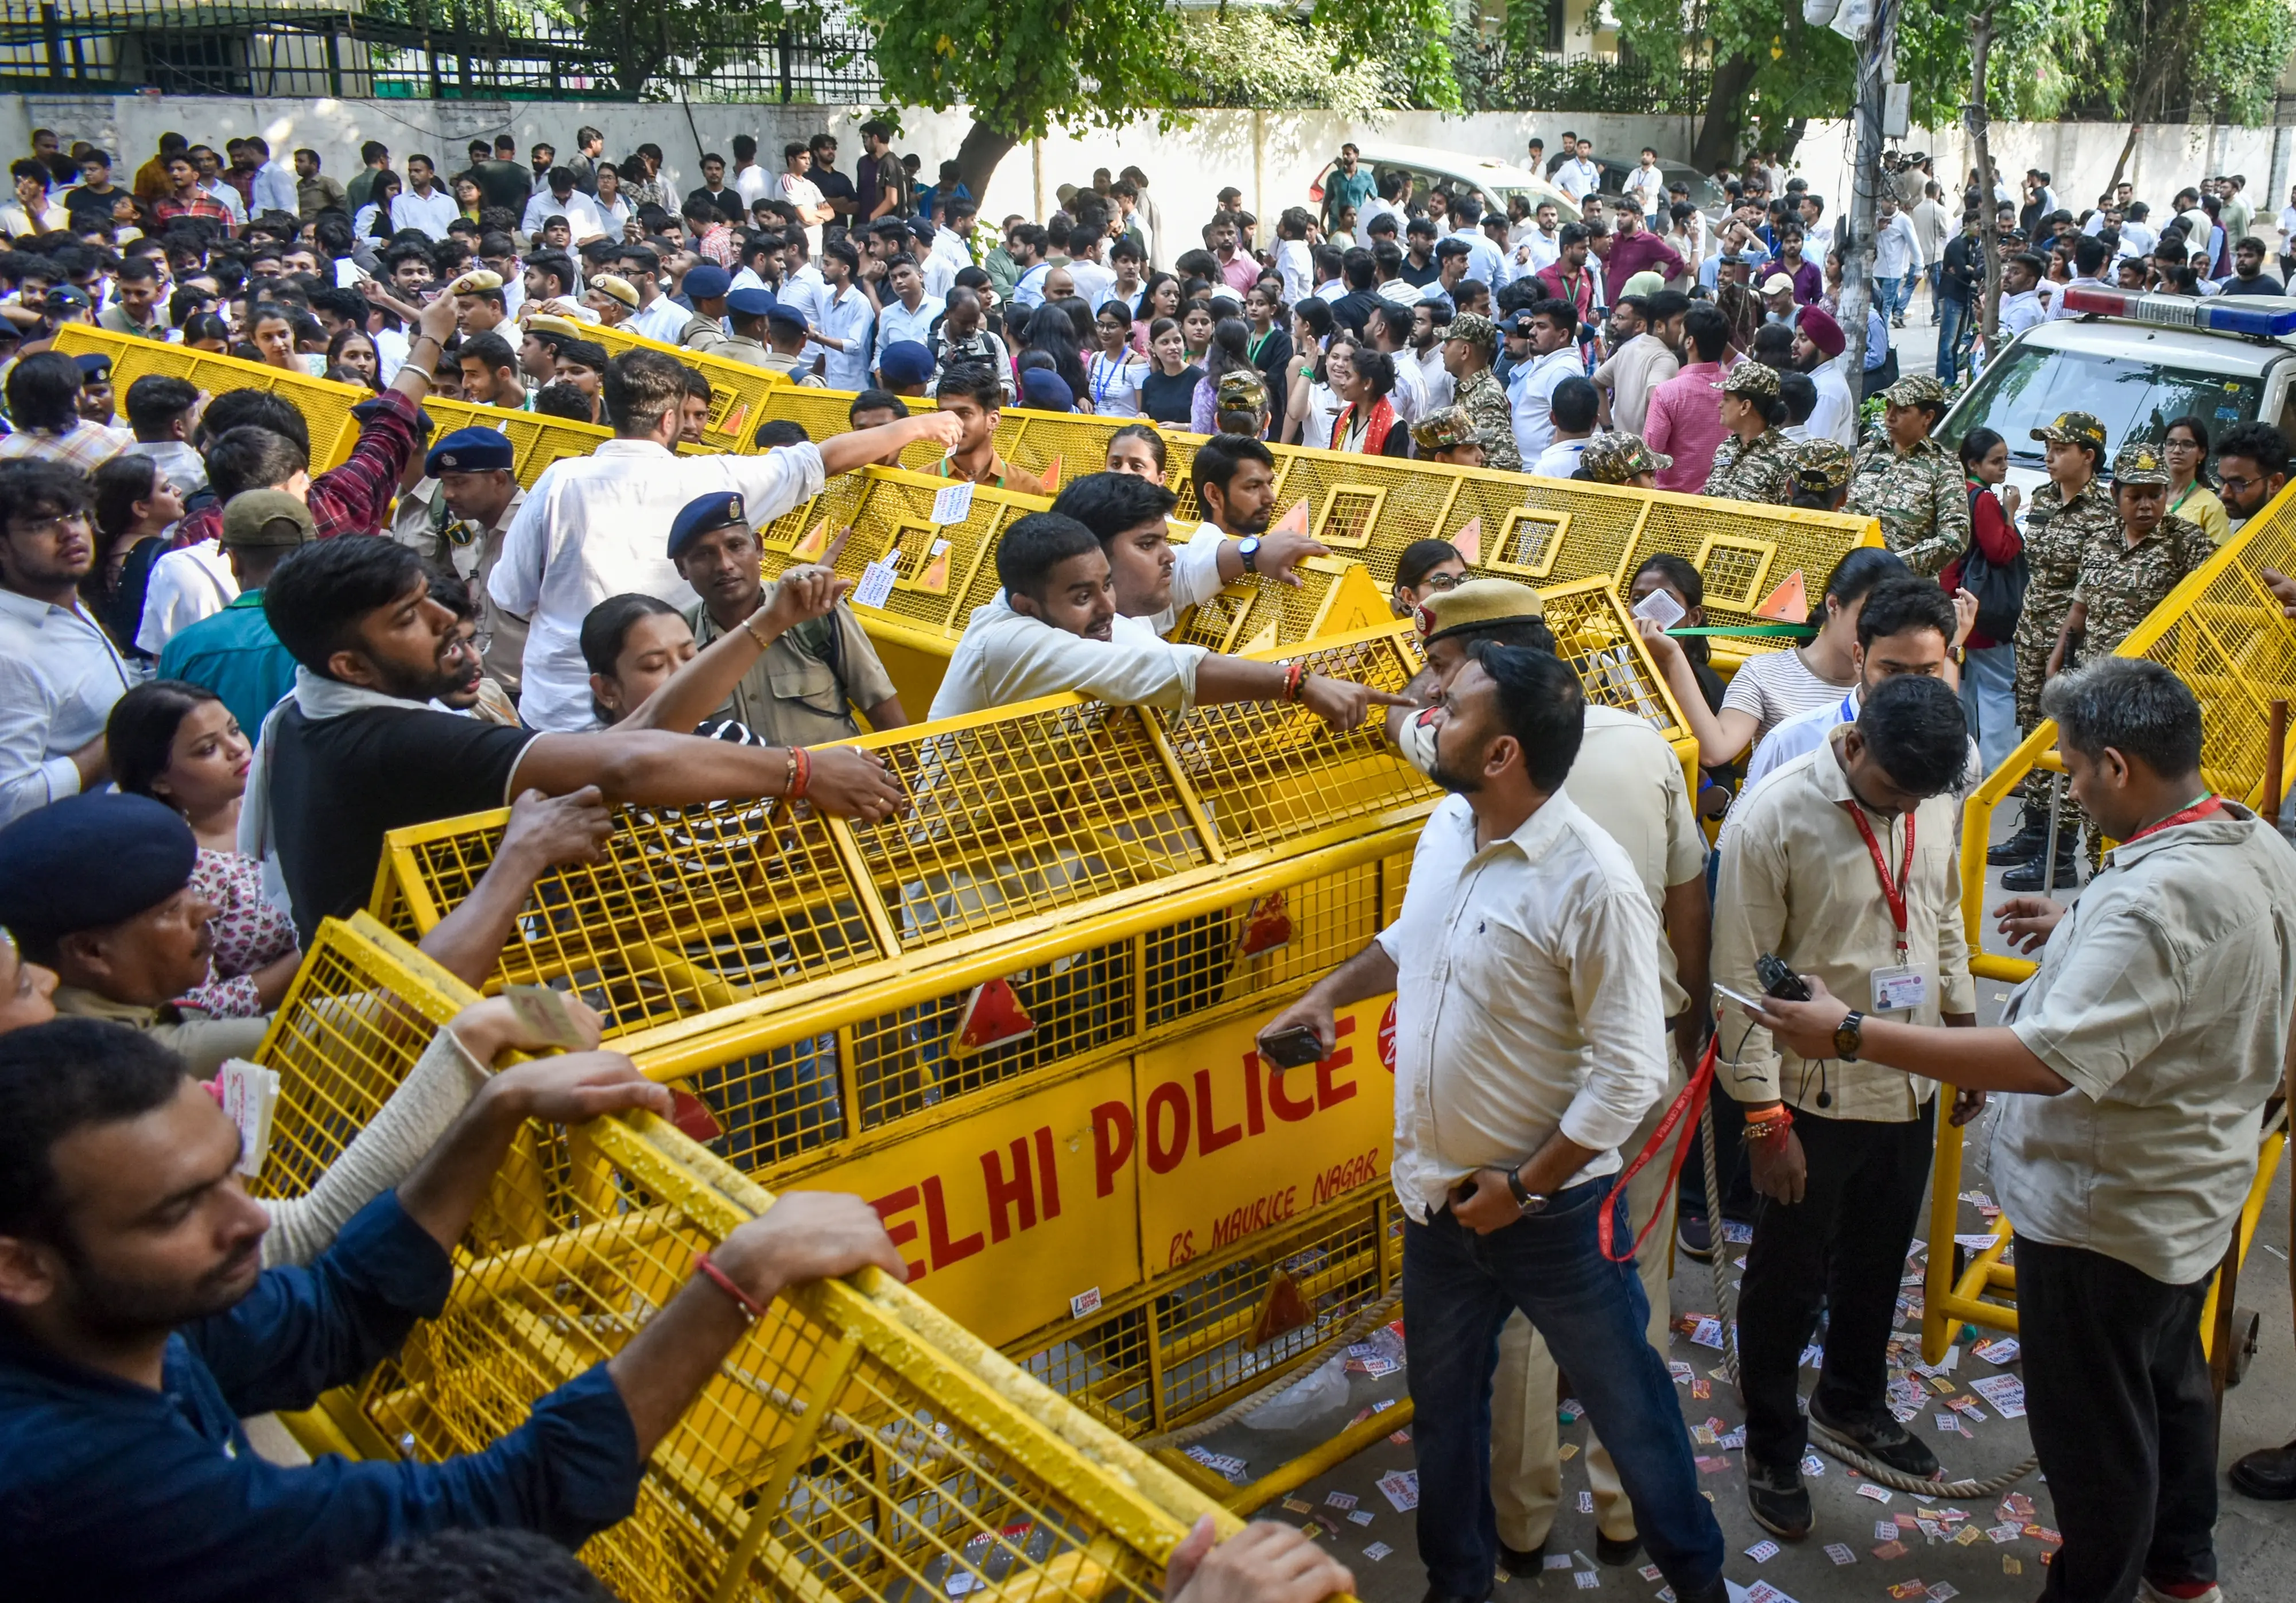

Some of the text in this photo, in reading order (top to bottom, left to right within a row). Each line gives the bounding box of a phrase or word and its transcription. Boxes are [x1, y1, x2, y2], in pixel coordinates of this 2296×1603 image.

[1877, 856, 1886, 871] LAW
[868, 1015, 1358, 1284] ELHI POLICE
[1169, 1147, 1379, 1267] P.S. MAURICE NAGAR
